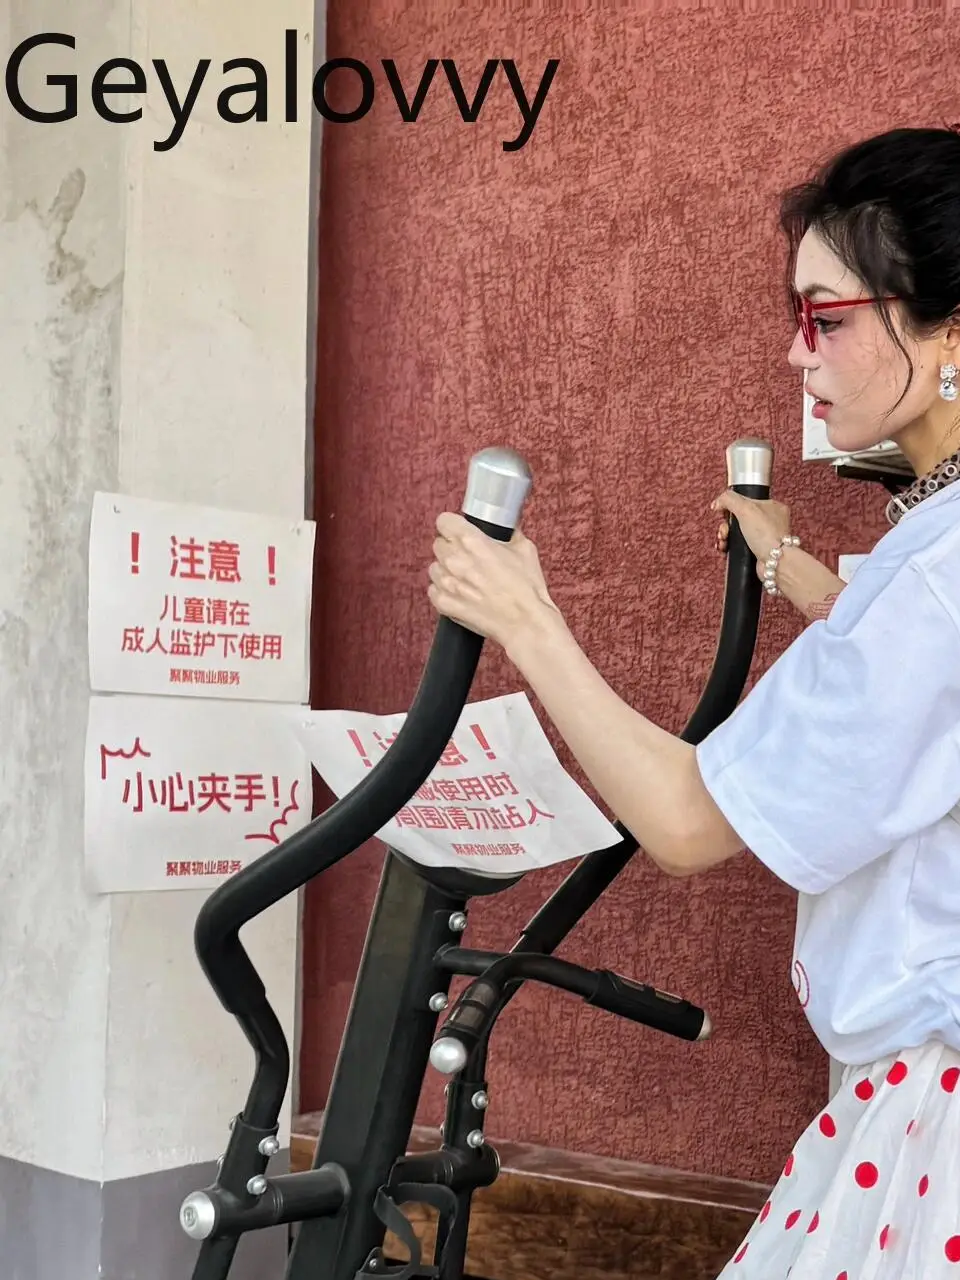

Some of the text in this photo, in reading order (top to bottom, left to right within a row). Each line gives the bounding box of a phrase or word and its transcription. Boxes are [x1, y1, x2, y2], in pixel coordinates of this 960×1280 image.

[170, 535, 242, 584] 注意
[159, 595, 250, 626] 儿童请在
[121, 626, 282, 660] 成人监护下使用
[122, 771, 280, 813] 小心夹手！
[395, 798, 555, 830] 周围请勿站人
